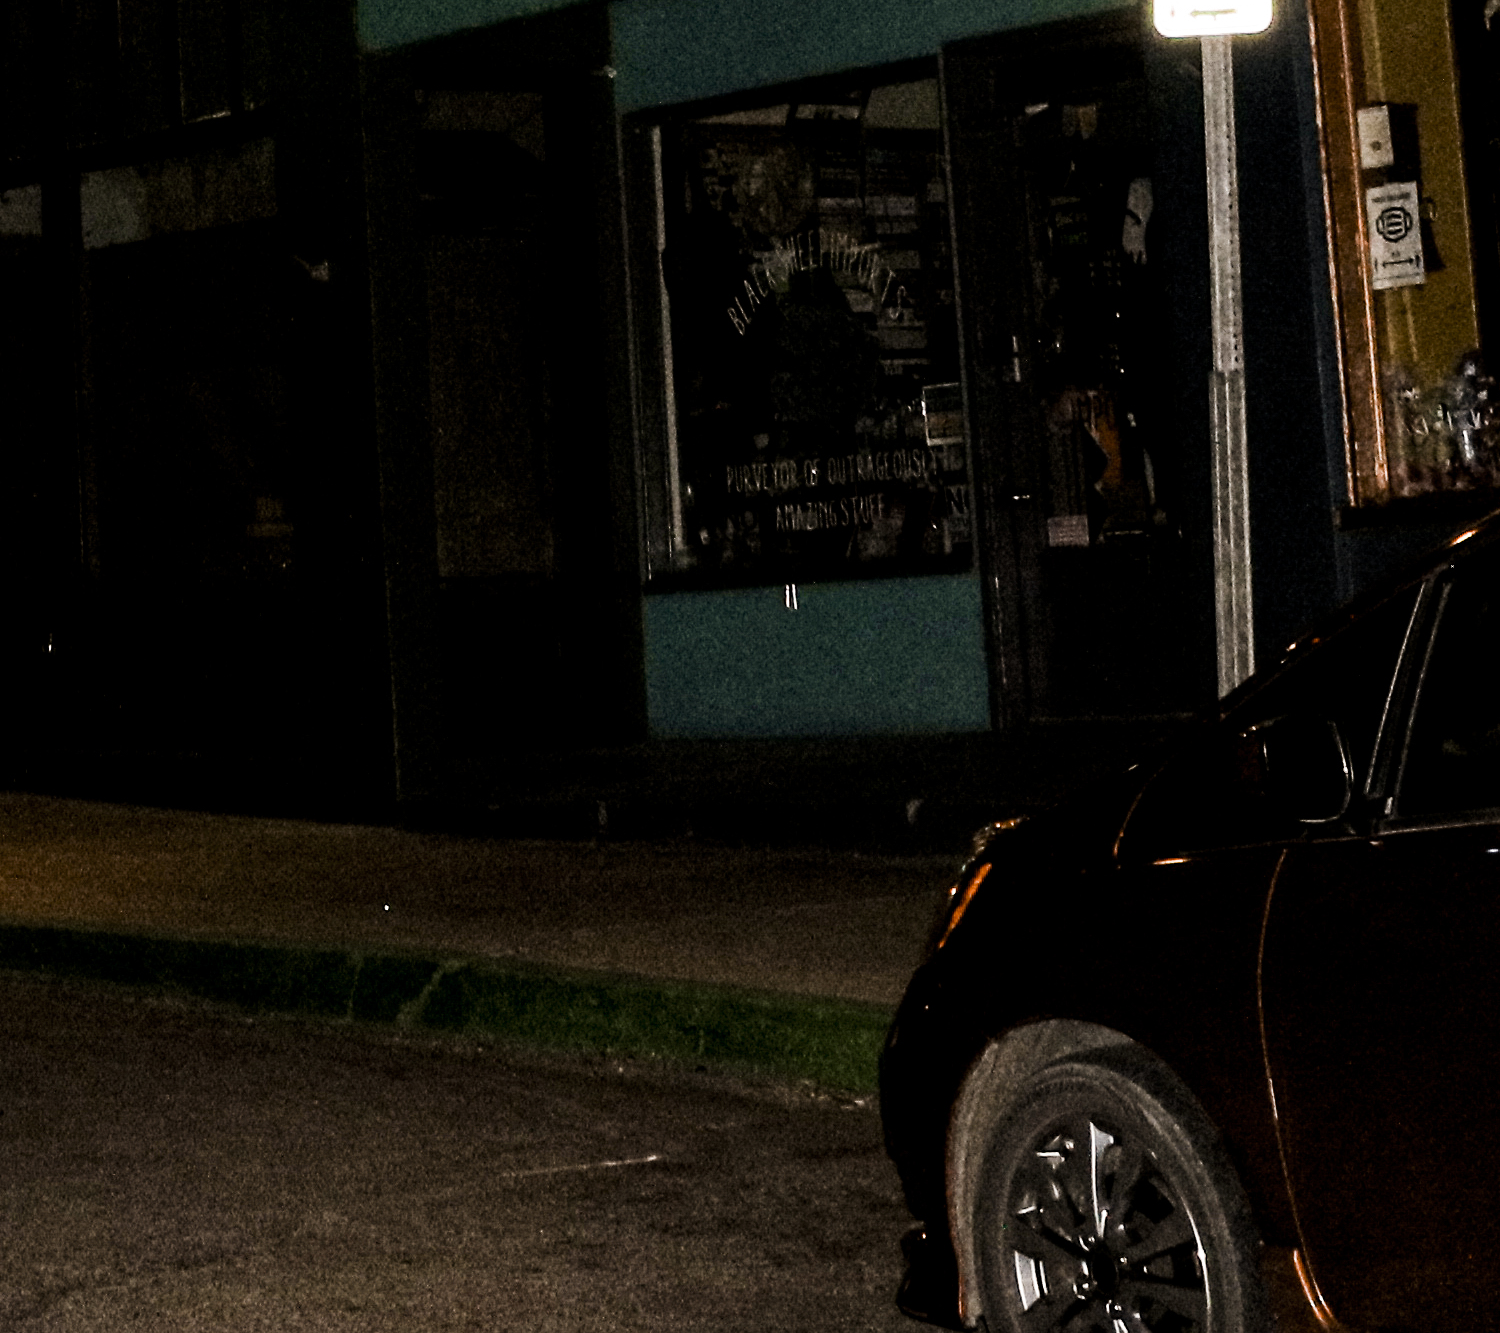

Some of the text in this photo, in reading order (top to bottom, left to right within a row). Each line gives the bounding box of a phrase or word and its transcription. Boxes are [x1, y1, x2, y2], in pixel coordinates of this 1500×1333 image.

[726, 459, 798, 494] PURVEYOR
[802, 457, 821, 488] OF
[775, 492, 886, 533] AMAZING STUFF
